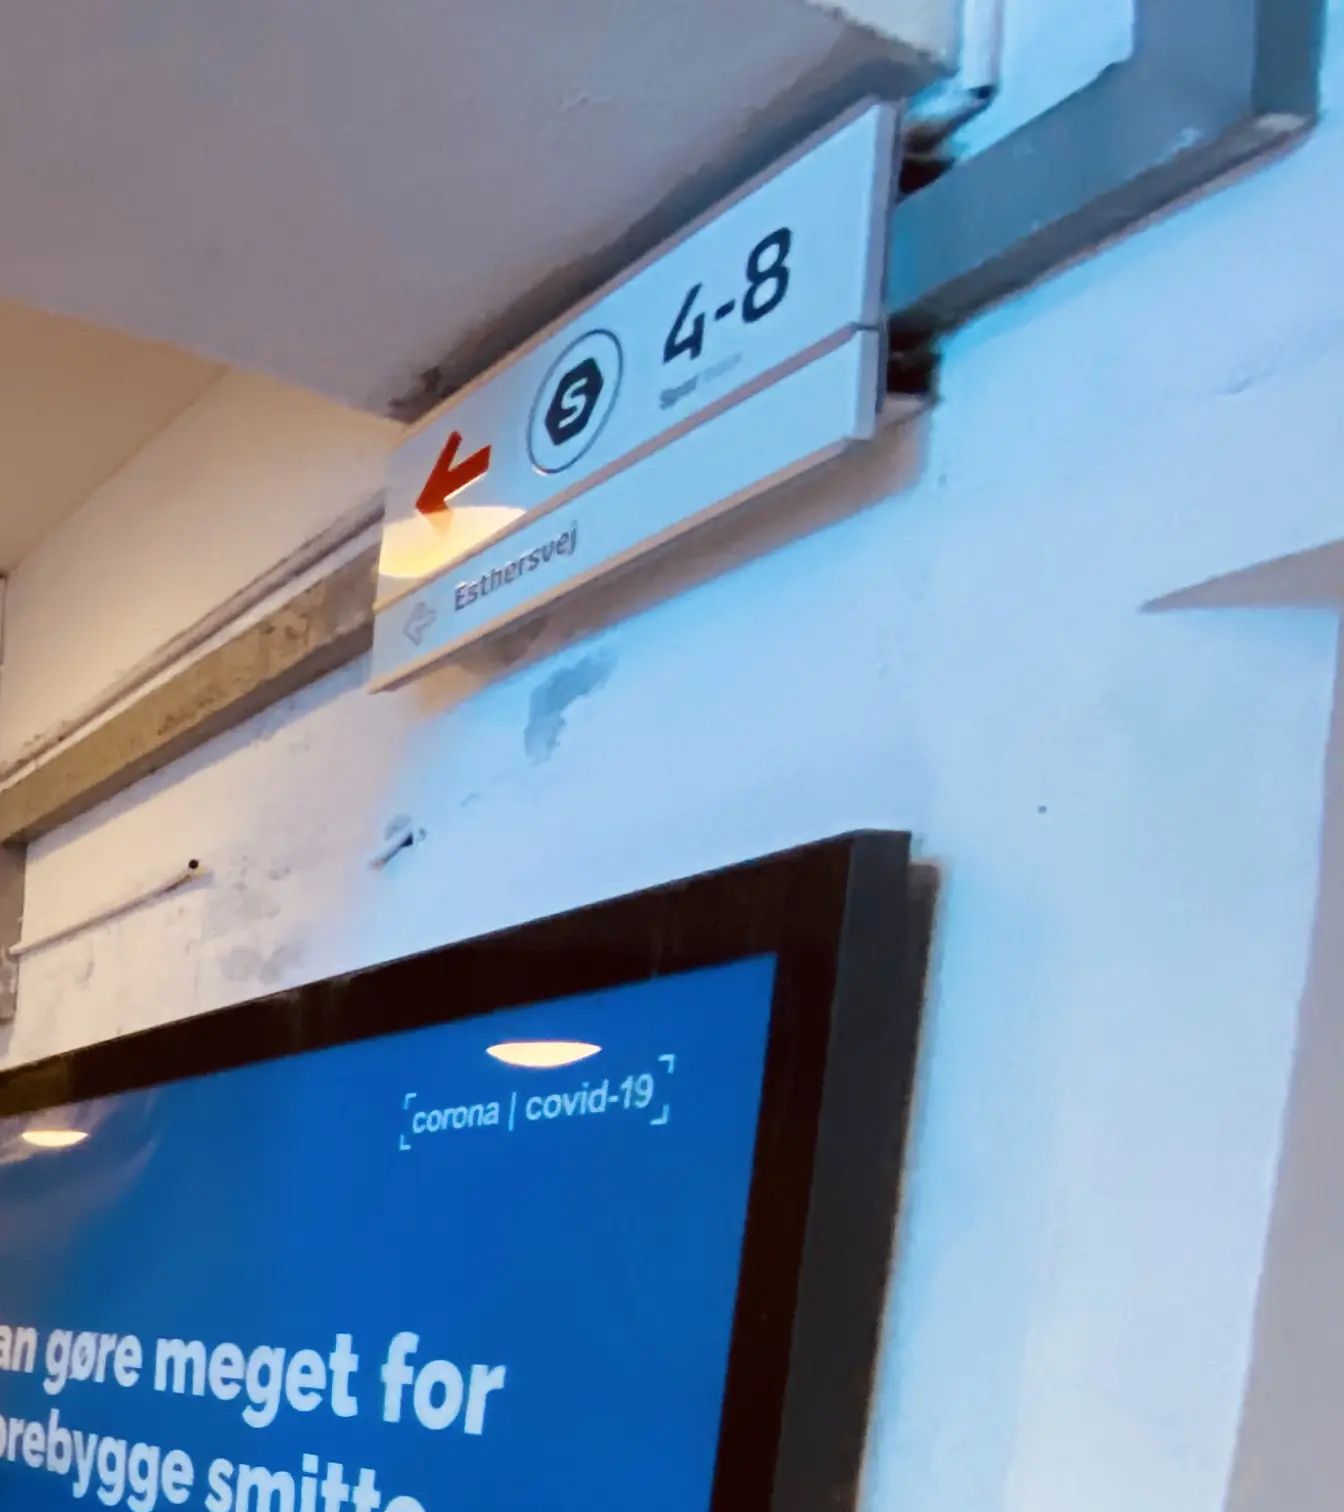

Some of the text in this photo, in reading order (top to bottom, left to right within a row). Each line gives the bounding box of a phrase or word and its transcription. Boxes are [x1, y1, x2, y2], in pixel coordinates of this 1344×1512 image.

[662, 226, 792, 365] 4-8
[453, 520, 578, 611] Esthersvej
[412, 1073, 654, 1134] corona covid-19
[42, 1328, 143, 1395] gøre
[153, 1333, 359, 1428] meget
[381, 1331, 506, 1436] for
